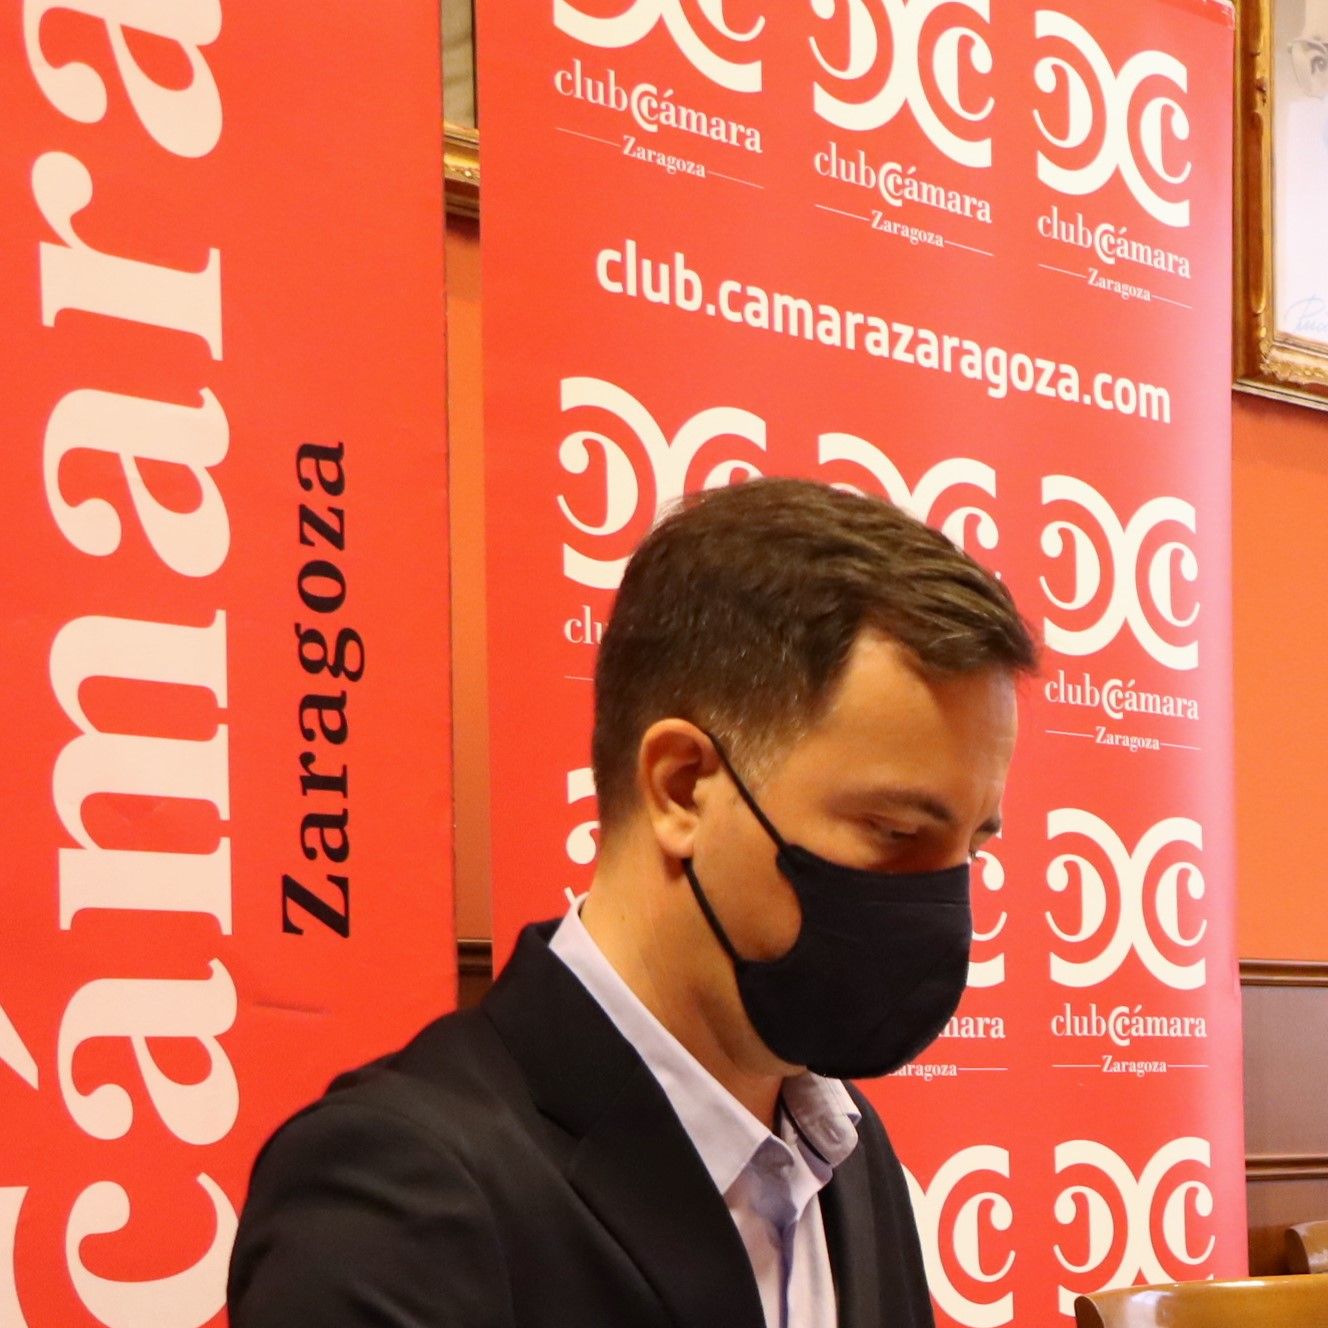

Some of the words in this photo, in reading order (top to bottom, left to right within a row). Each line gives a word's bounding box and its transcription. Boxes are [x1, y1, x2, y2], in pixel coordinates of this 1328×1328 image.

[622, 134, 706, 179] Zaragoza
[870, 209, 944, 245] Zaragoza
[1087, 267, 1151, 300] Zaragoza
[595, 239, 1172, 424] club.camarazaragoza.com
[281, 440, 366, 939] Zaragoza
[1095, 725, 1160, 752] Zaragoza
[889, 1064, 957, 1082] aragoza
[1102, 1055, 1167, 1077] Zaragoza
